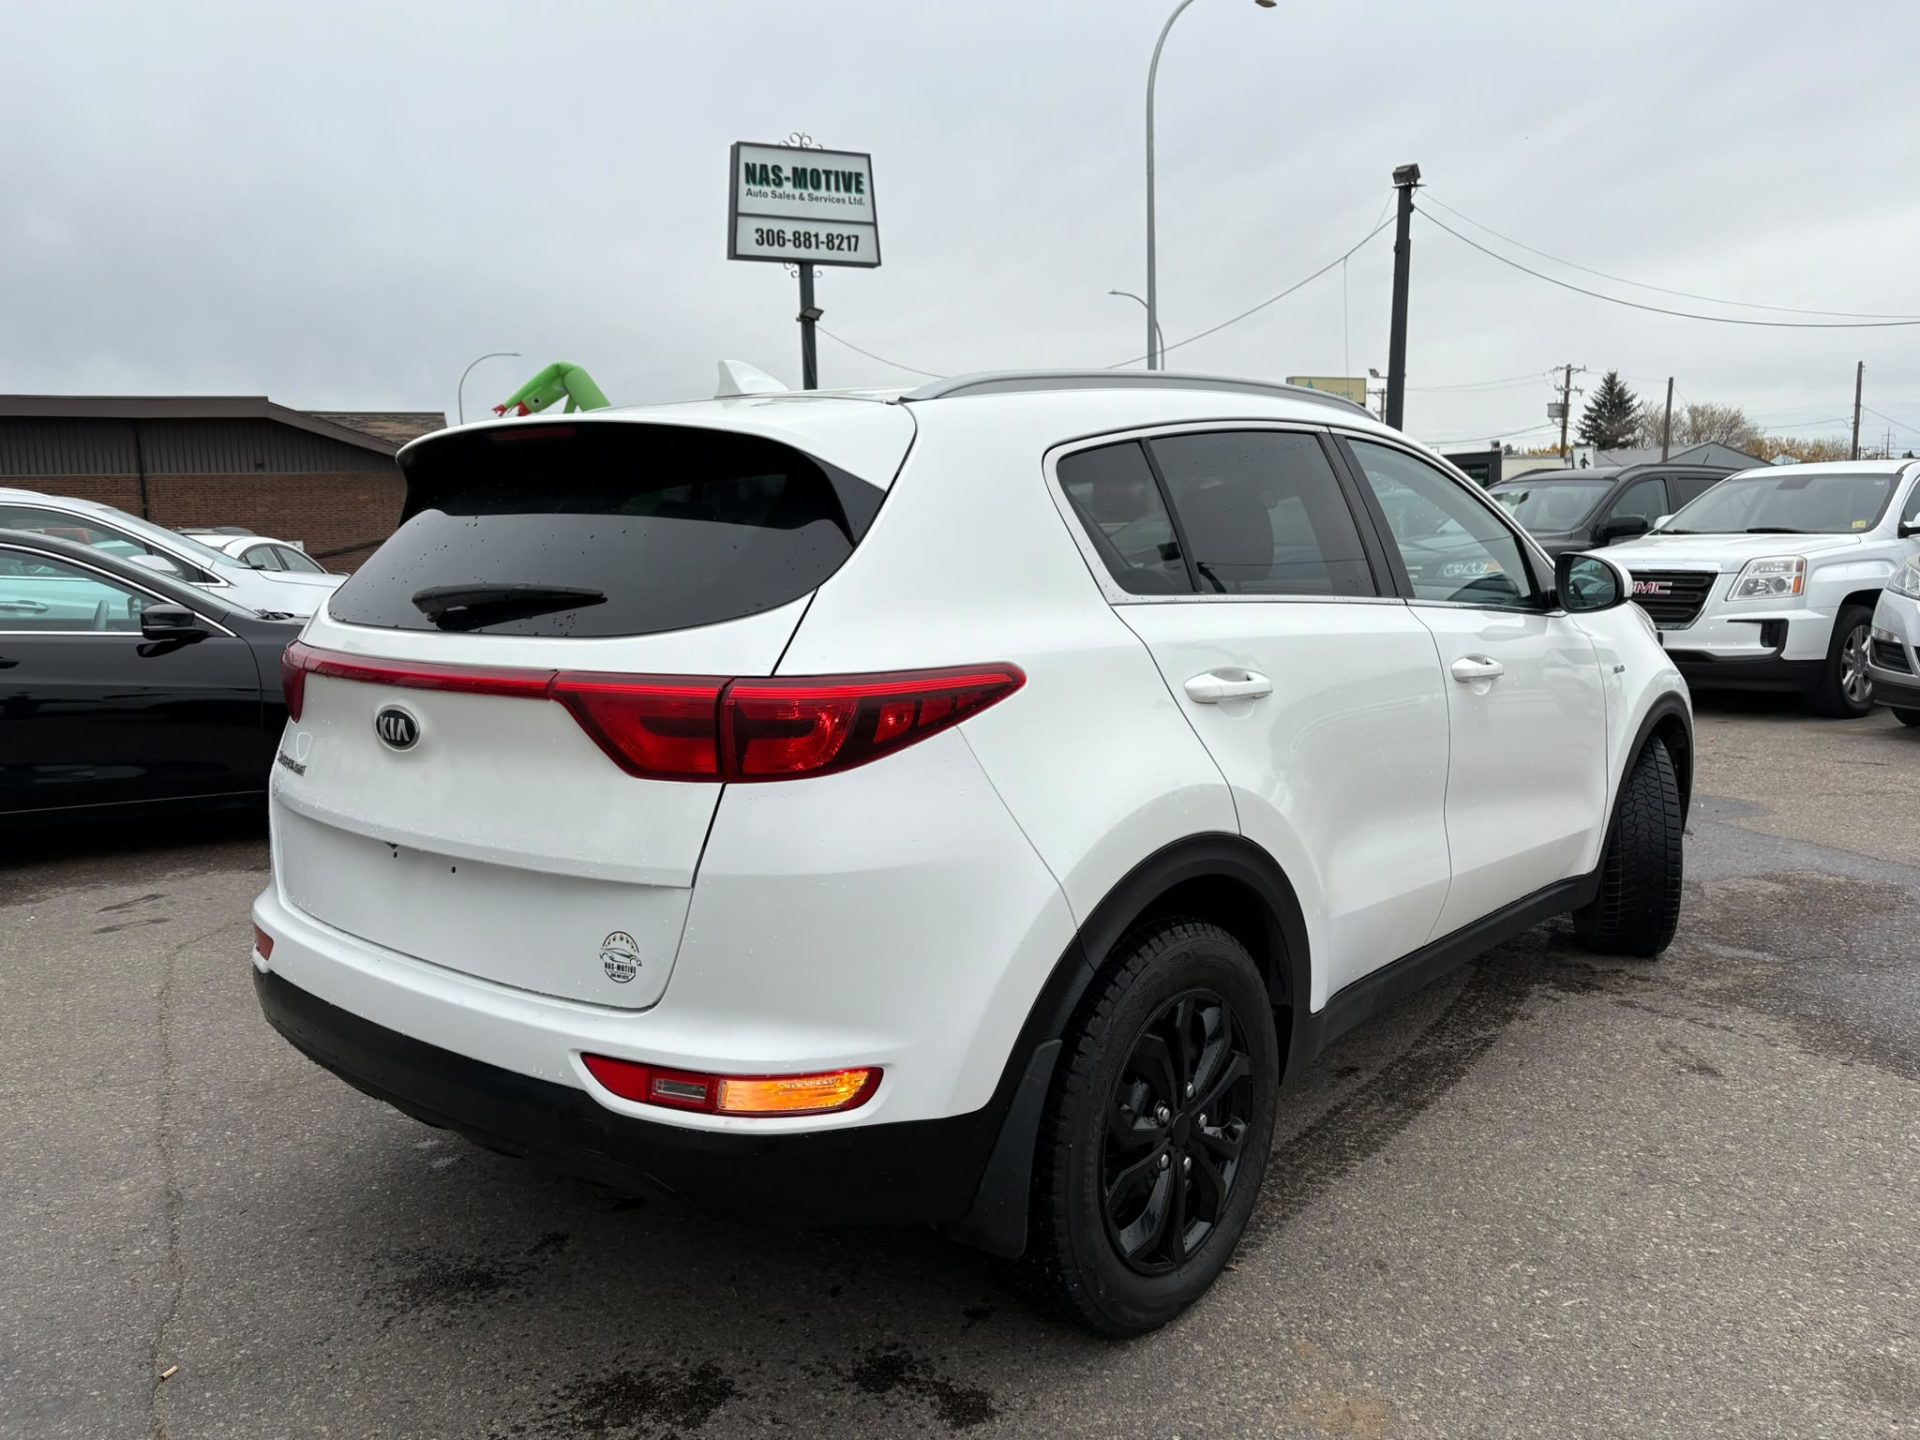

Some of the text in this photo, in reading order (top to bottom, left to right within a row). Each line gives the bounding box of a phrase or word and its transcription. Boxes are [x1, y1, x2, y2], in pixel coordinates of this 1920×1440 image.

[744, 162, 865, 195] NAS-MOTIVE
[746, 188, 865, 206] Auto Sales & Services Ltd.
[755, 228, 859, 252] 306-881-8217
[1633, 581, 1673, 595] MC
[379, 715, 410, 742] KIA
